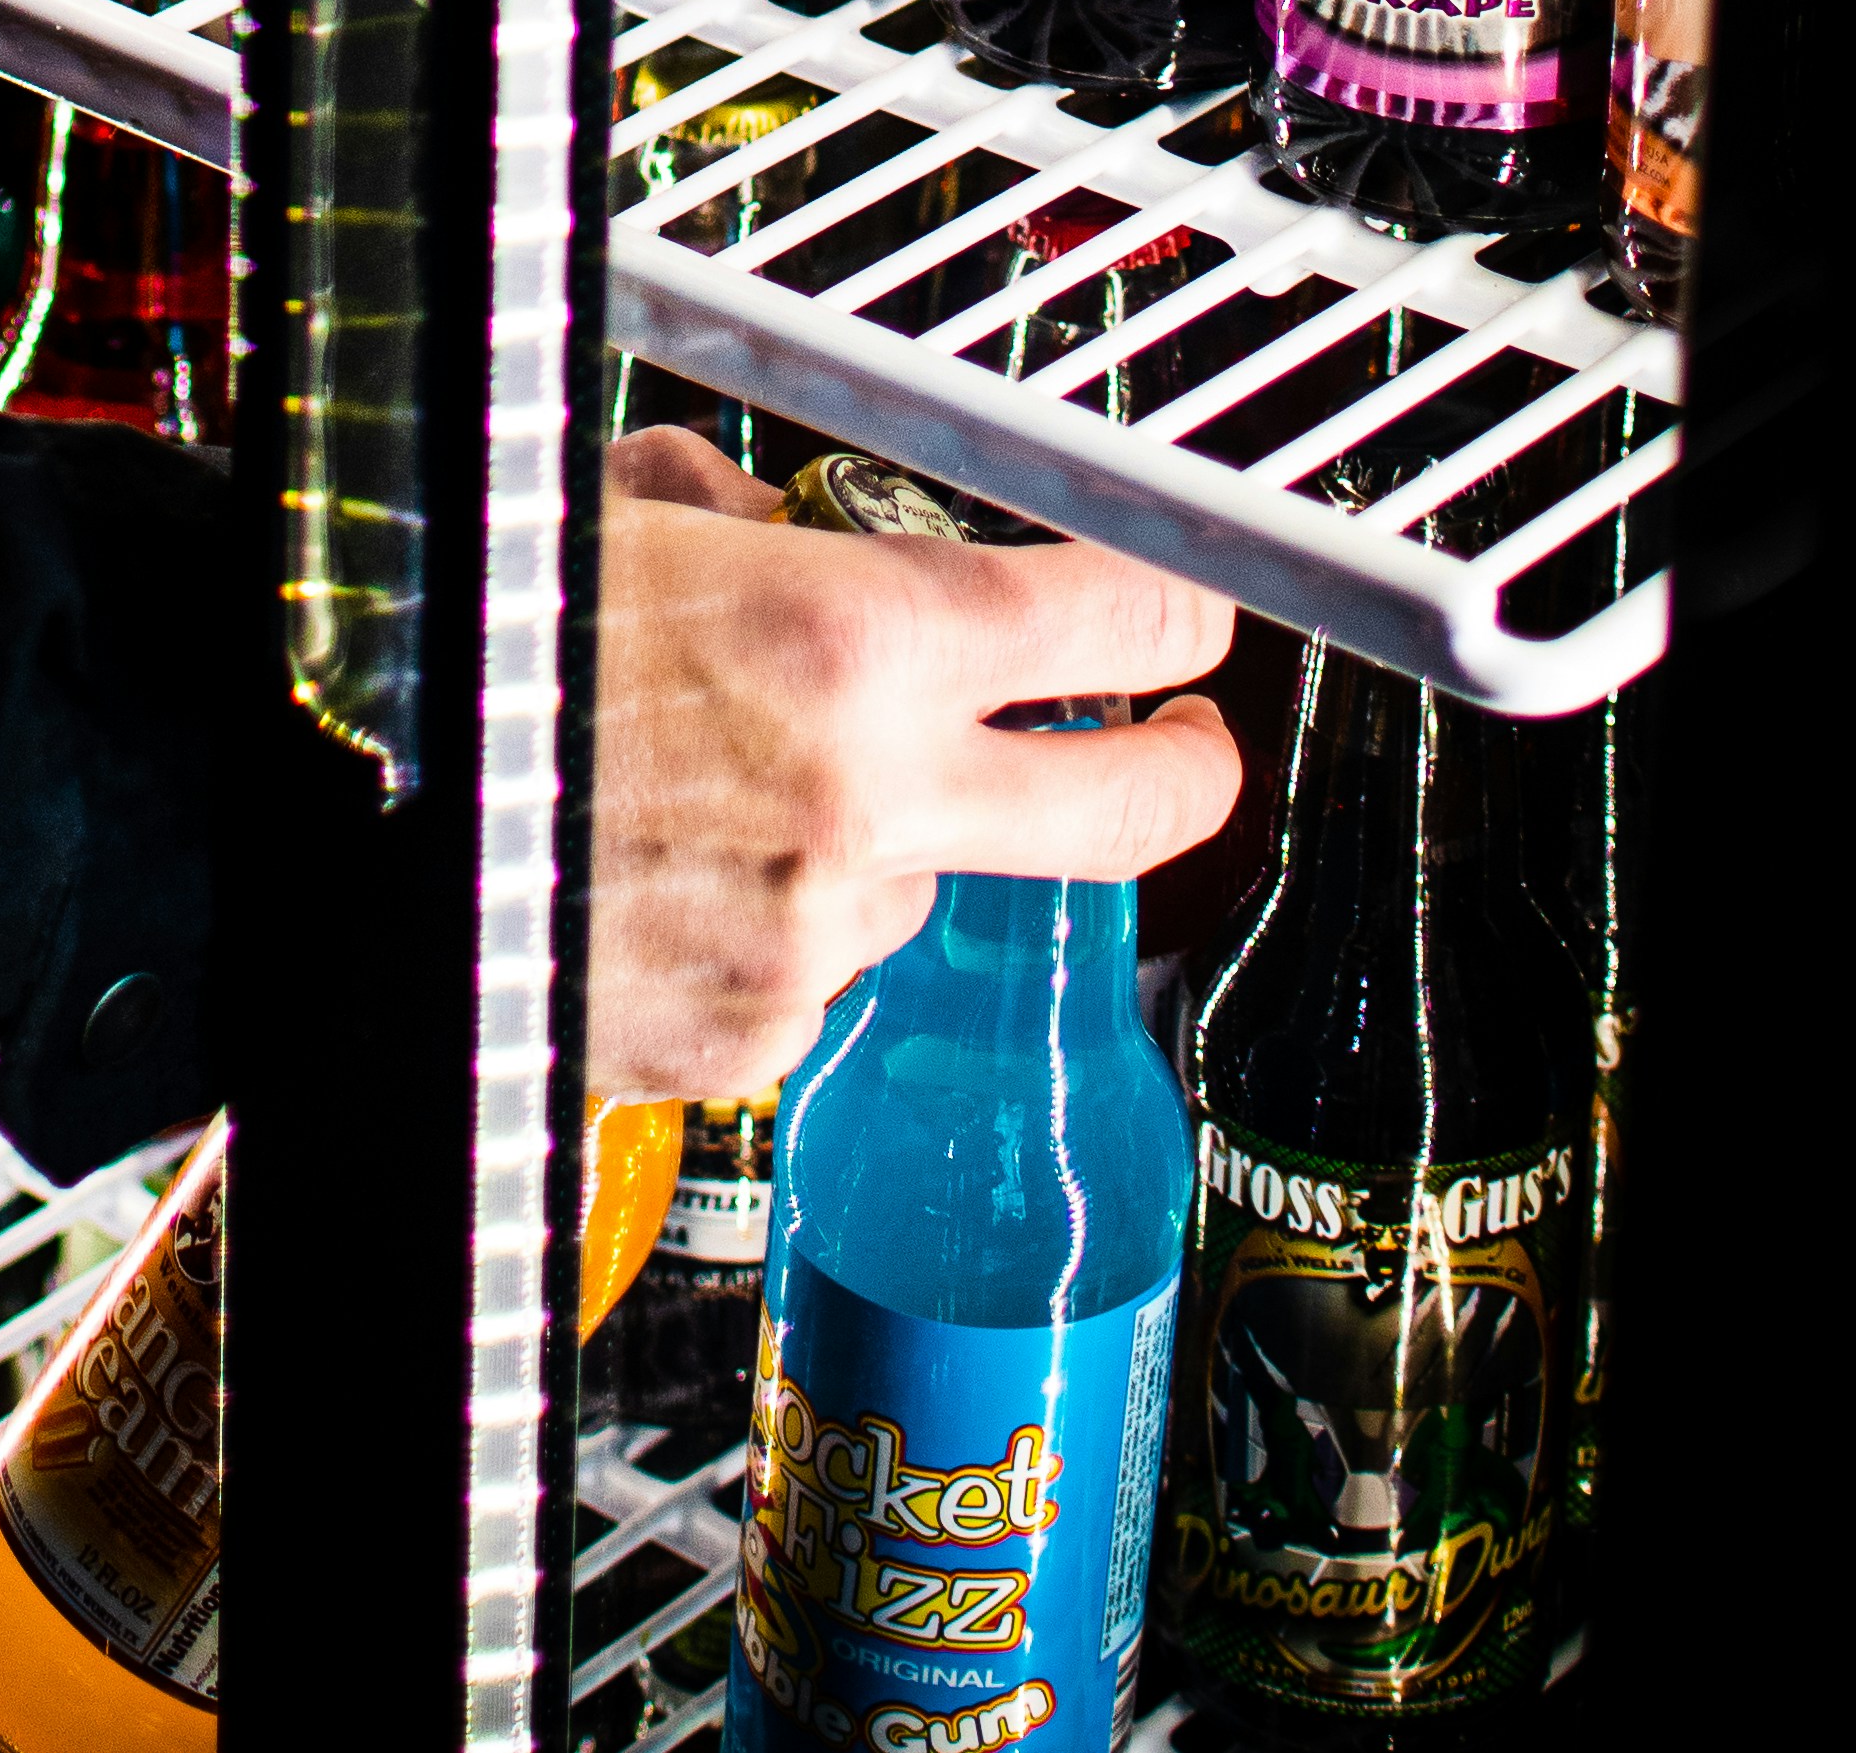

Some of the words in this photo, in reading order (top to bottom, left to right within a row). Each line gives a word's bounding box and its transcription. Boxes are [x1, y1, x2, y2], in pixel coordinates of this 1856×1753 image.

[748, 1301, 1052, 1542] Rocket
[73, 1543, 103, 1573] 12
[781, 1462, 1020, 1641] Fizz
[1174, 1511, 1423, 1620] Dinosaur
[833, 1636, 1006, 1690] ORIGINAL
[869, 1688, 1050, 1753] Gum
